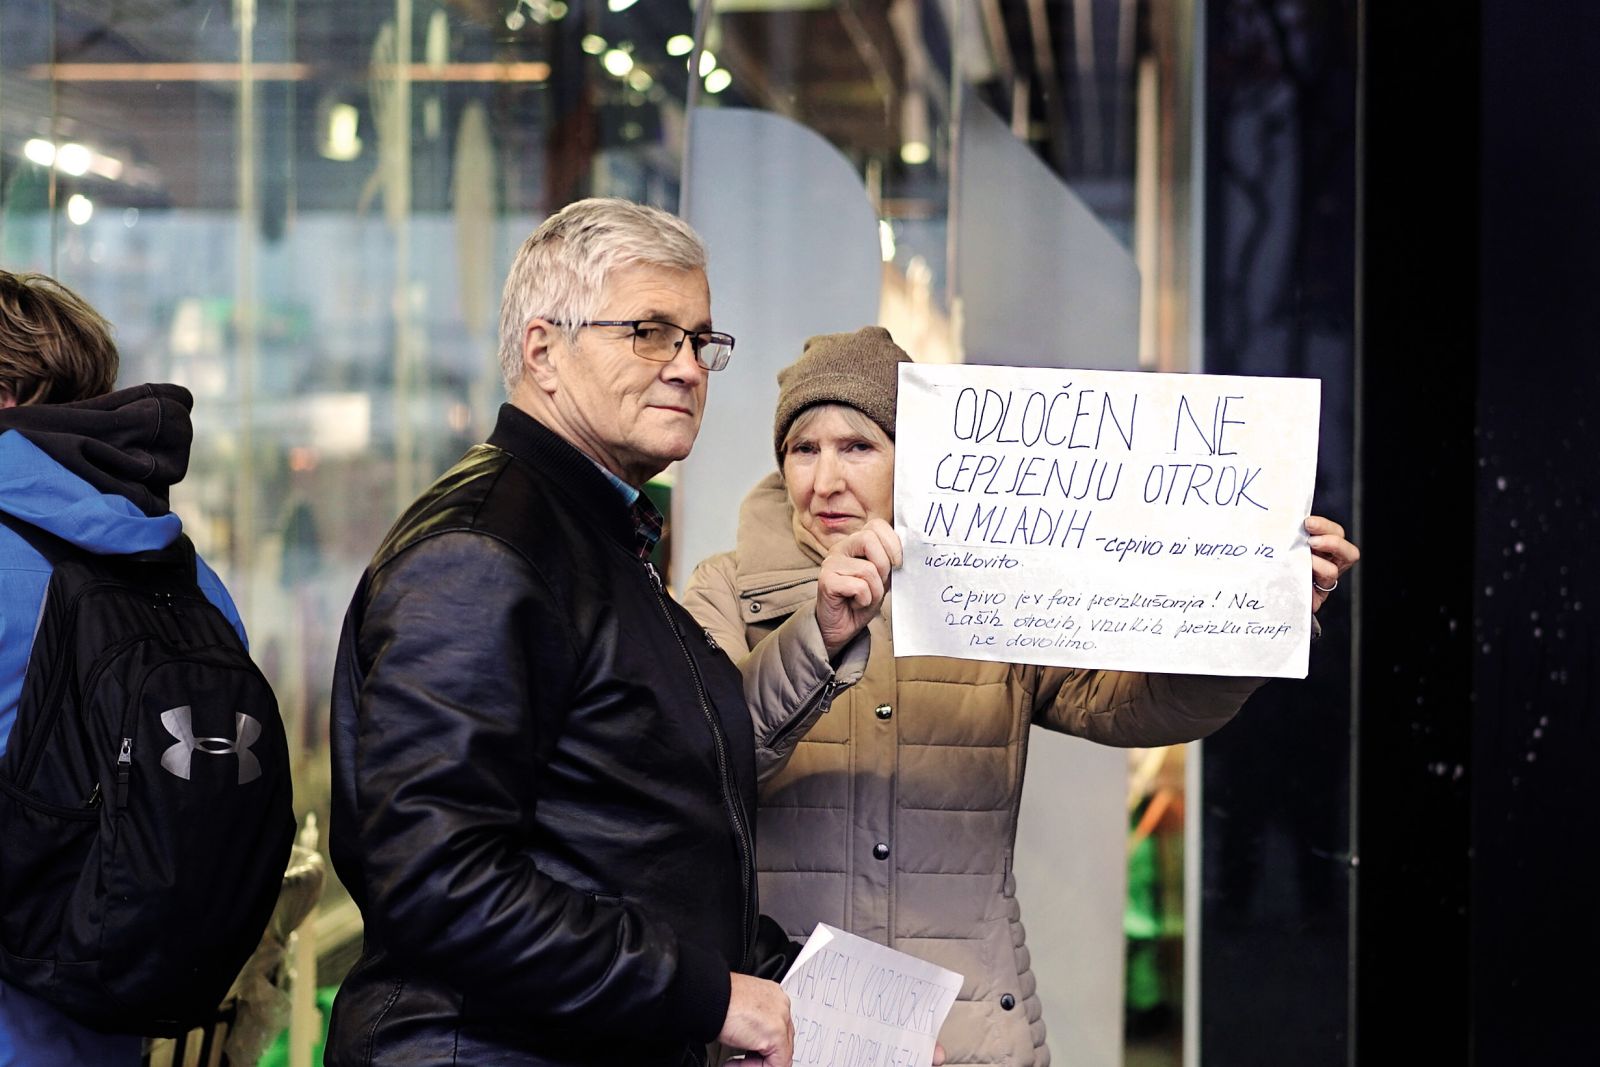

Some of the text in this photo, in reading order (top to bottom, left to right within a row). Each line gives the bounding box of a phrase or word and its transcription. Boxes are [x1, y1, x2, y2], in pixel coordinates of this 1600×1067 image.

[954, 382, 1246, 456] ODLOČEN NE
[935, 452, 1269, 511] CEPLJENJU OTROK
[924, 501, 960, 538] IN
[964, 502, 1093, 549] MLADIH
[1168, 536, 1191, 555] ni
[1194, 542, 1248, 557] varno
[1254, 543, 1274, 559] in
[941, 585, 1007, 610] Cepivo
[1227, 592, 1266, 610] Na
[944, 608, 1004, 627] naših
[1090, 616, 1164, 635] vnukih
[969, 633, 997, 647] ne
